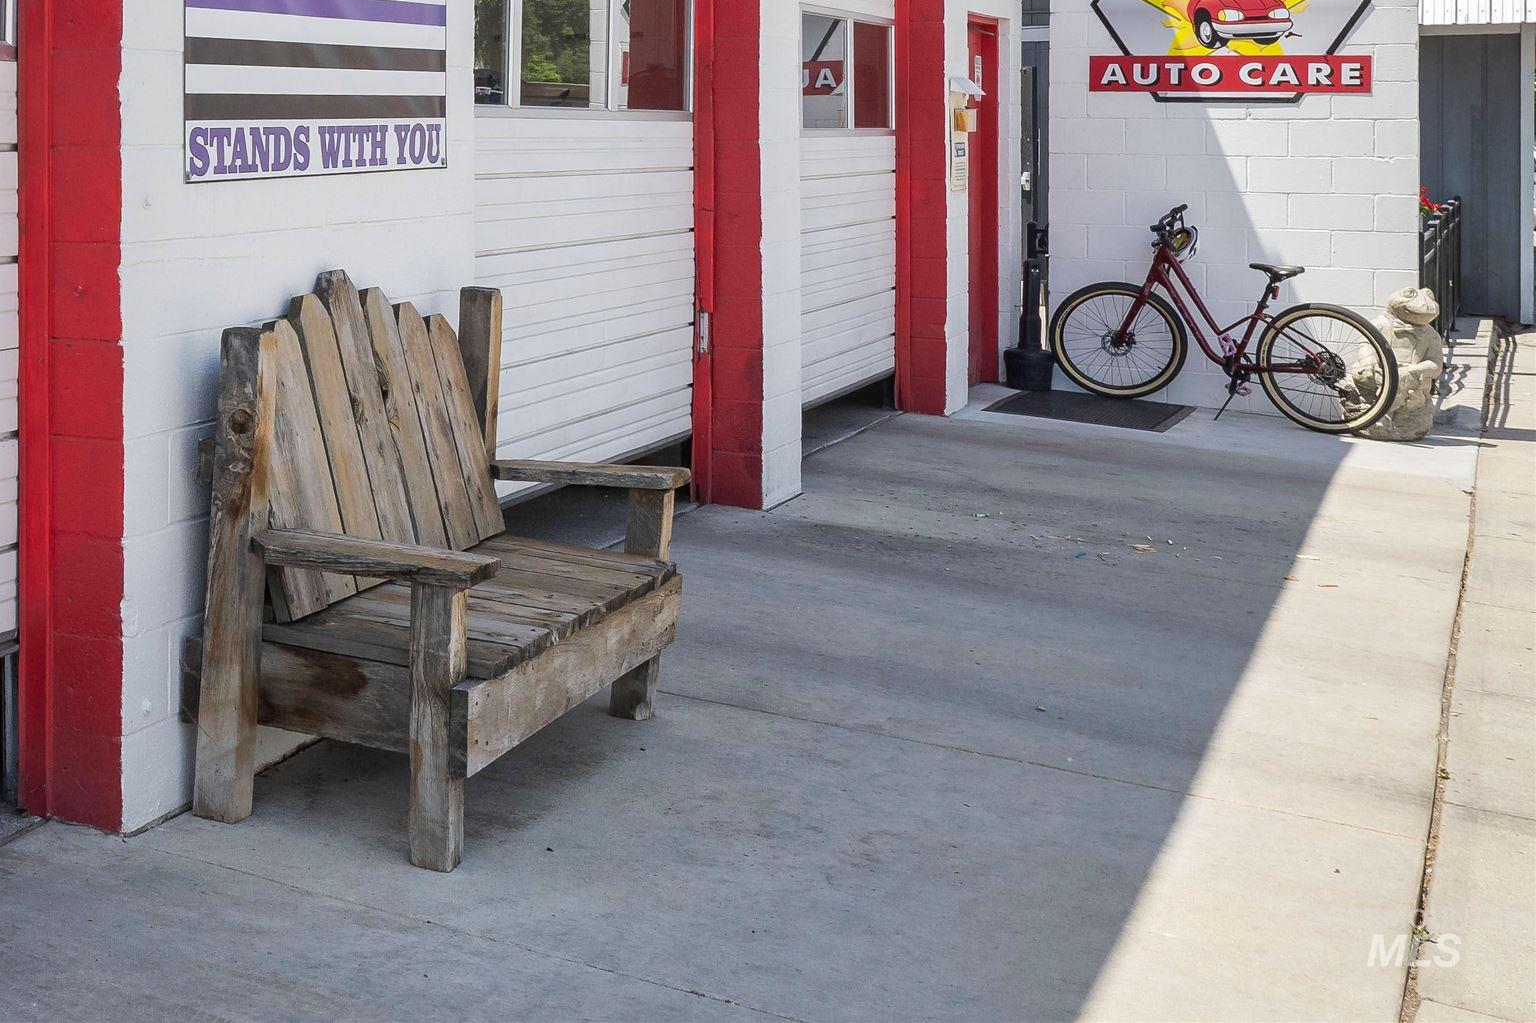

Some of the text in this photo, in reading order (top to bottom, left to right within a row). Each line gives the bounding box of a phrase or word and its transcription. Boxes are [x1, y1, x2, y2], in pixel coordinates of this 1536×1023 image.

[1101, 63, 1363, 86] AUTO CARE
[189, 122, 441, 177] STANDS WITH YOU
